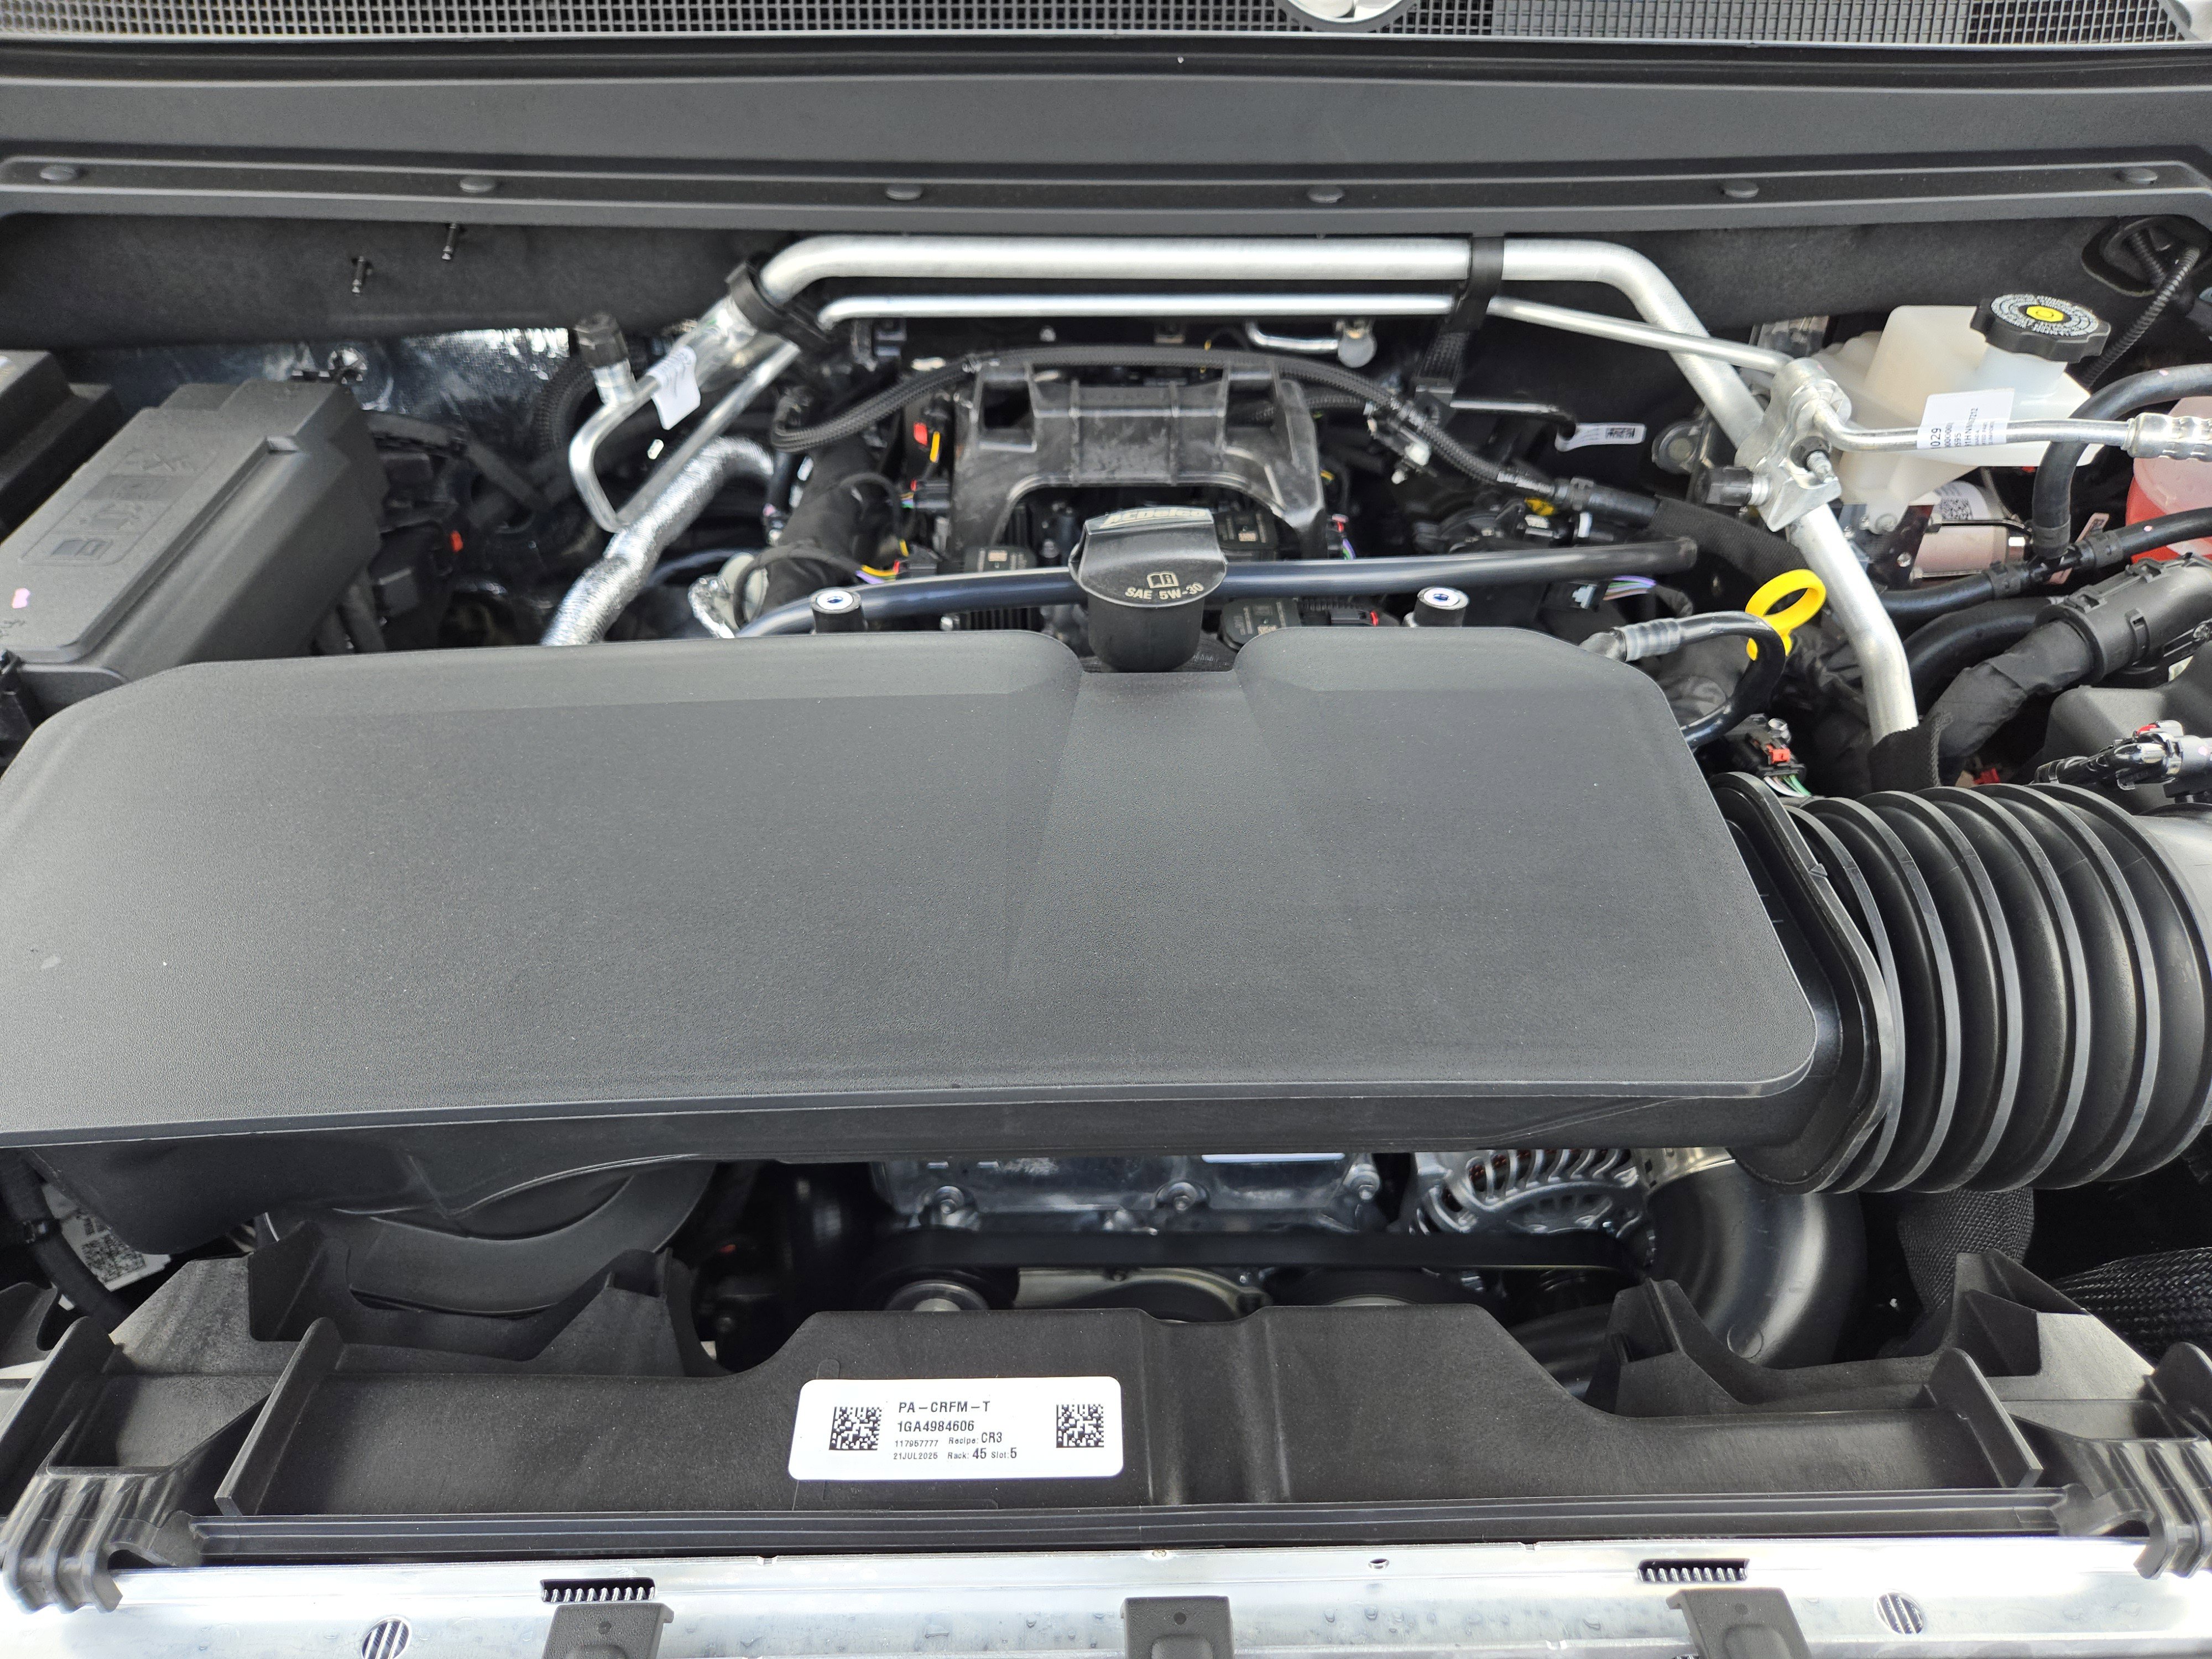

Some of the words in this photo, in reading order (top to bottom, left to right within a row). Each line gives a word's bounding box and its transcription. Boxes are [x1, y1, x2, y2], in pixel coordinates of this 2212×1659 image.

[1099, 509, 1206, 529] ACDelco
[1125, 587, 1153, 600] SAE
[1159, 582, 1204, 600] 5W-30
[897, 1420, 975, 1432] 1GA4984606
[948, 1437, 979, 1445] Recipe:
[981, 1432, 1003, 1443] CR3
[972, 1447, 987, 1459] 45
